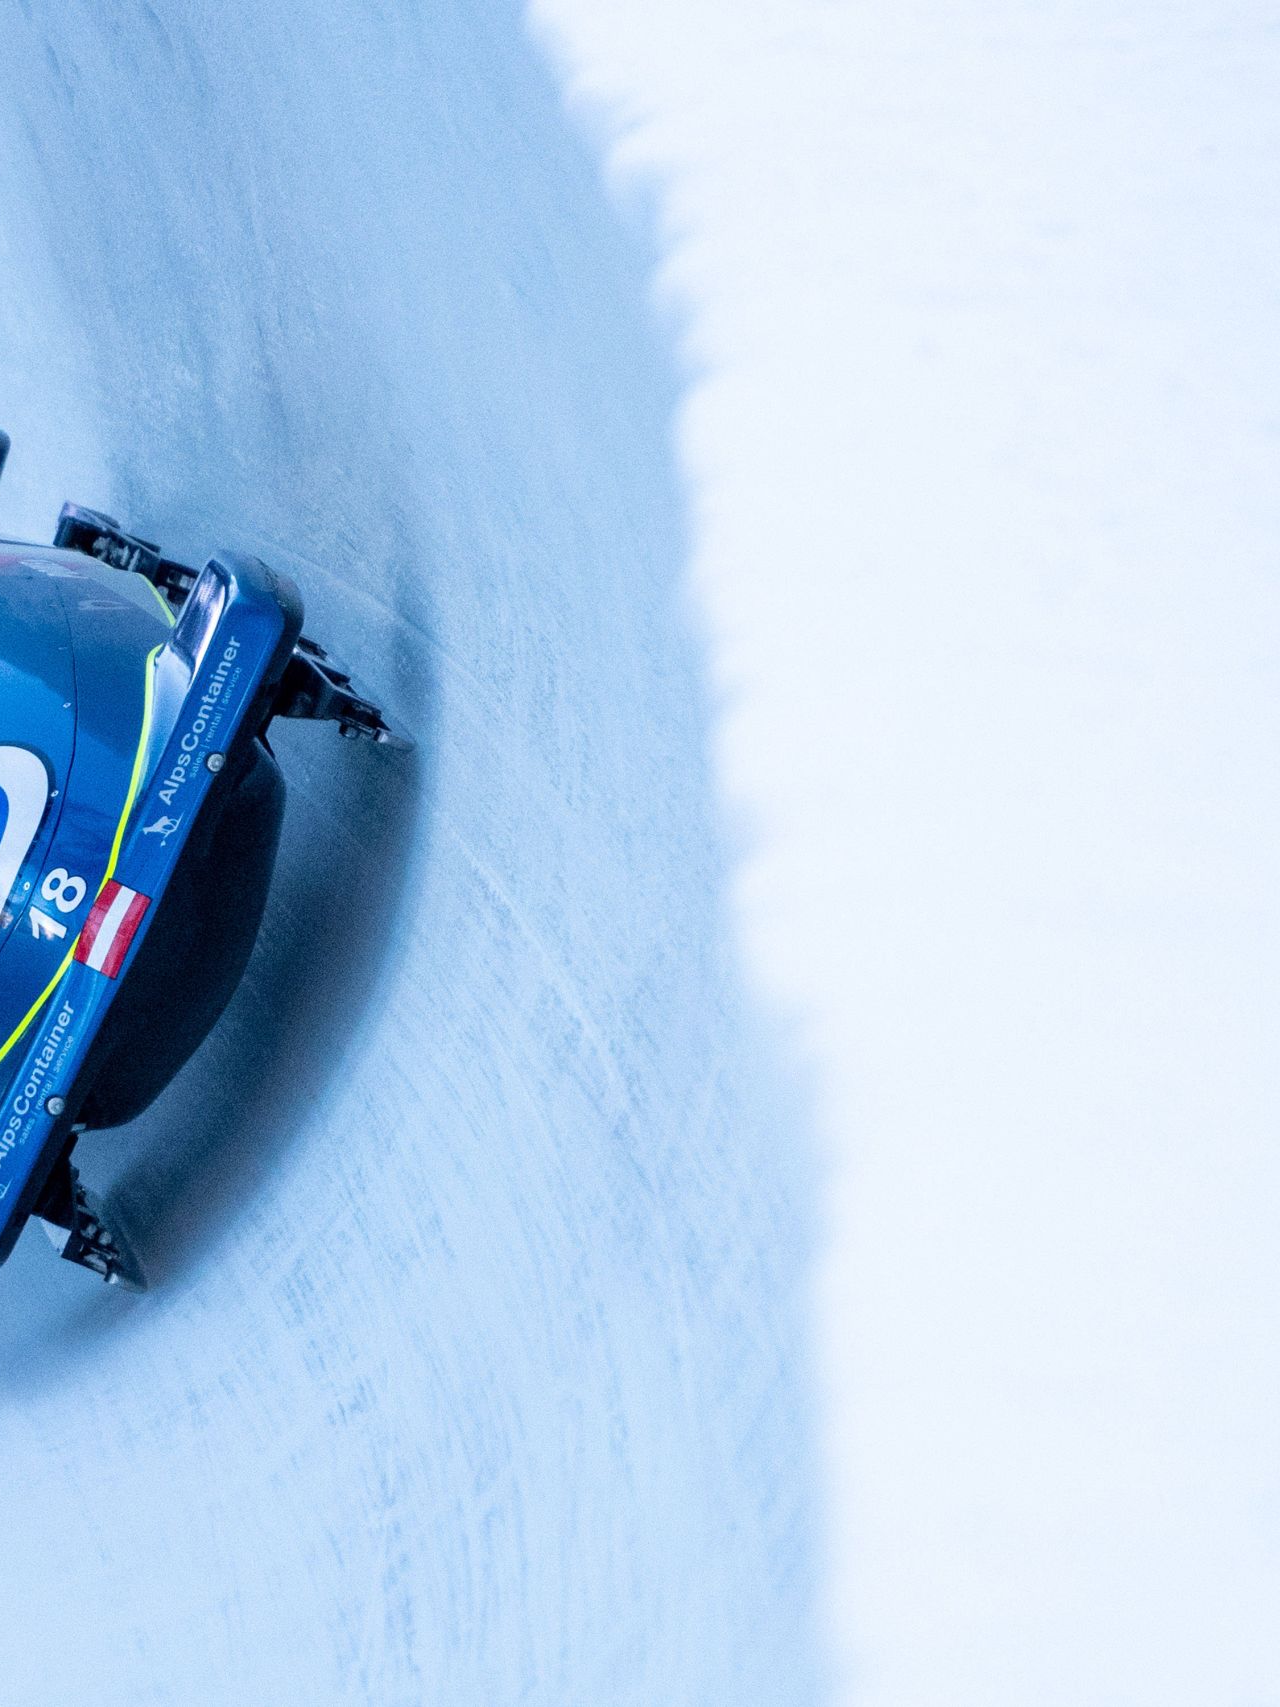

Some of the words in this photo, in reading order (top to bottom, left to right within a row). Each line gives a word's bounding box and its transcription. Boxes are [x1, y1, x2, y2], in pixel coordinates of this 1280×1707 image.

[159, 635, 241, 806] AlpsContainer
[190, 750, 207, 778] sales
[205, 713, 223, 744] rental
[222, 666, 243, 706] service
[29, 867, 87, 940] 18
[19, 1117, 36, 1145] sales
[35, 1080, 53, 1111] rental
[53, 1035, 74, 1073] service
